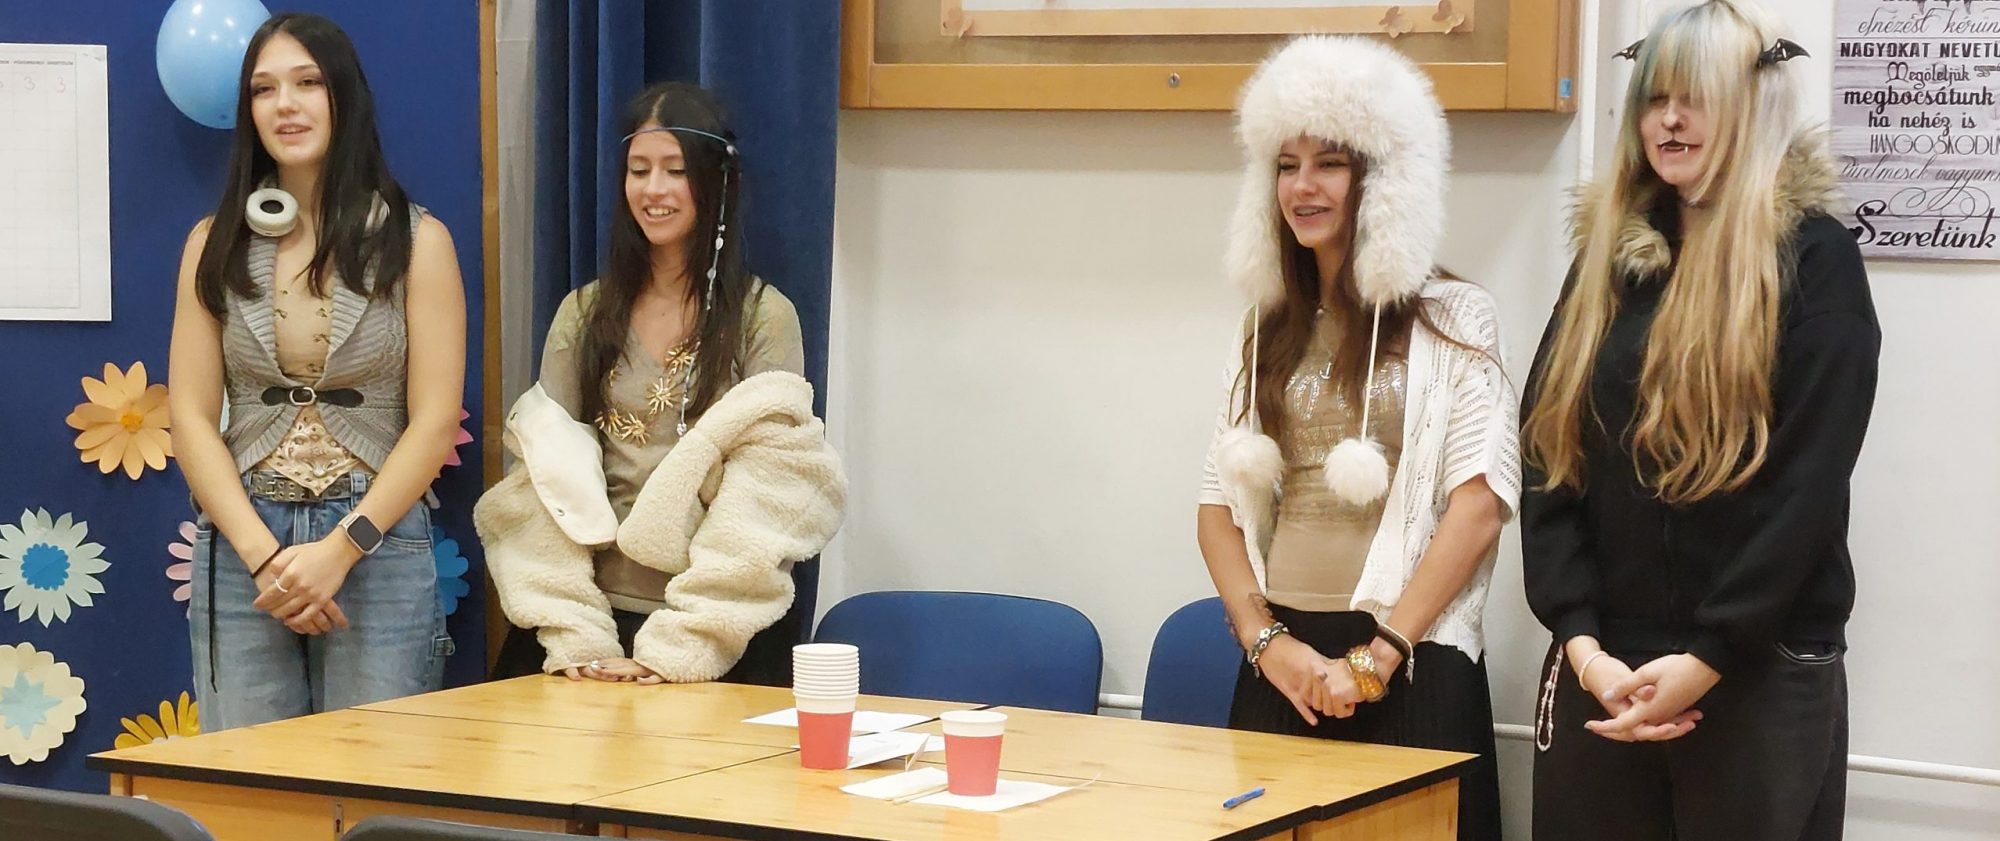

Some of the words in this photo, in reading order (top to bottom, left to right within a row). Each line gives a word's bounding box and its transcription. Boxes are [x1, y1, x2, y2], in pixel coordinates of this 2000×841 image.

[1943, 8, 2000, 34] kérün
[1840, 42, 1931, 58] NAGYOKAT
[1885, 61, 1971, 89] Megöleljük
[1844, 85, 1995, 115] megbocsátunk
[1868, 110, 1891, 128] ha
[1900, 111, 1952, 136] nehéz
[1961, 112, 1977, 128] is
[1850, 199, 1997, 249] Szeretünk
